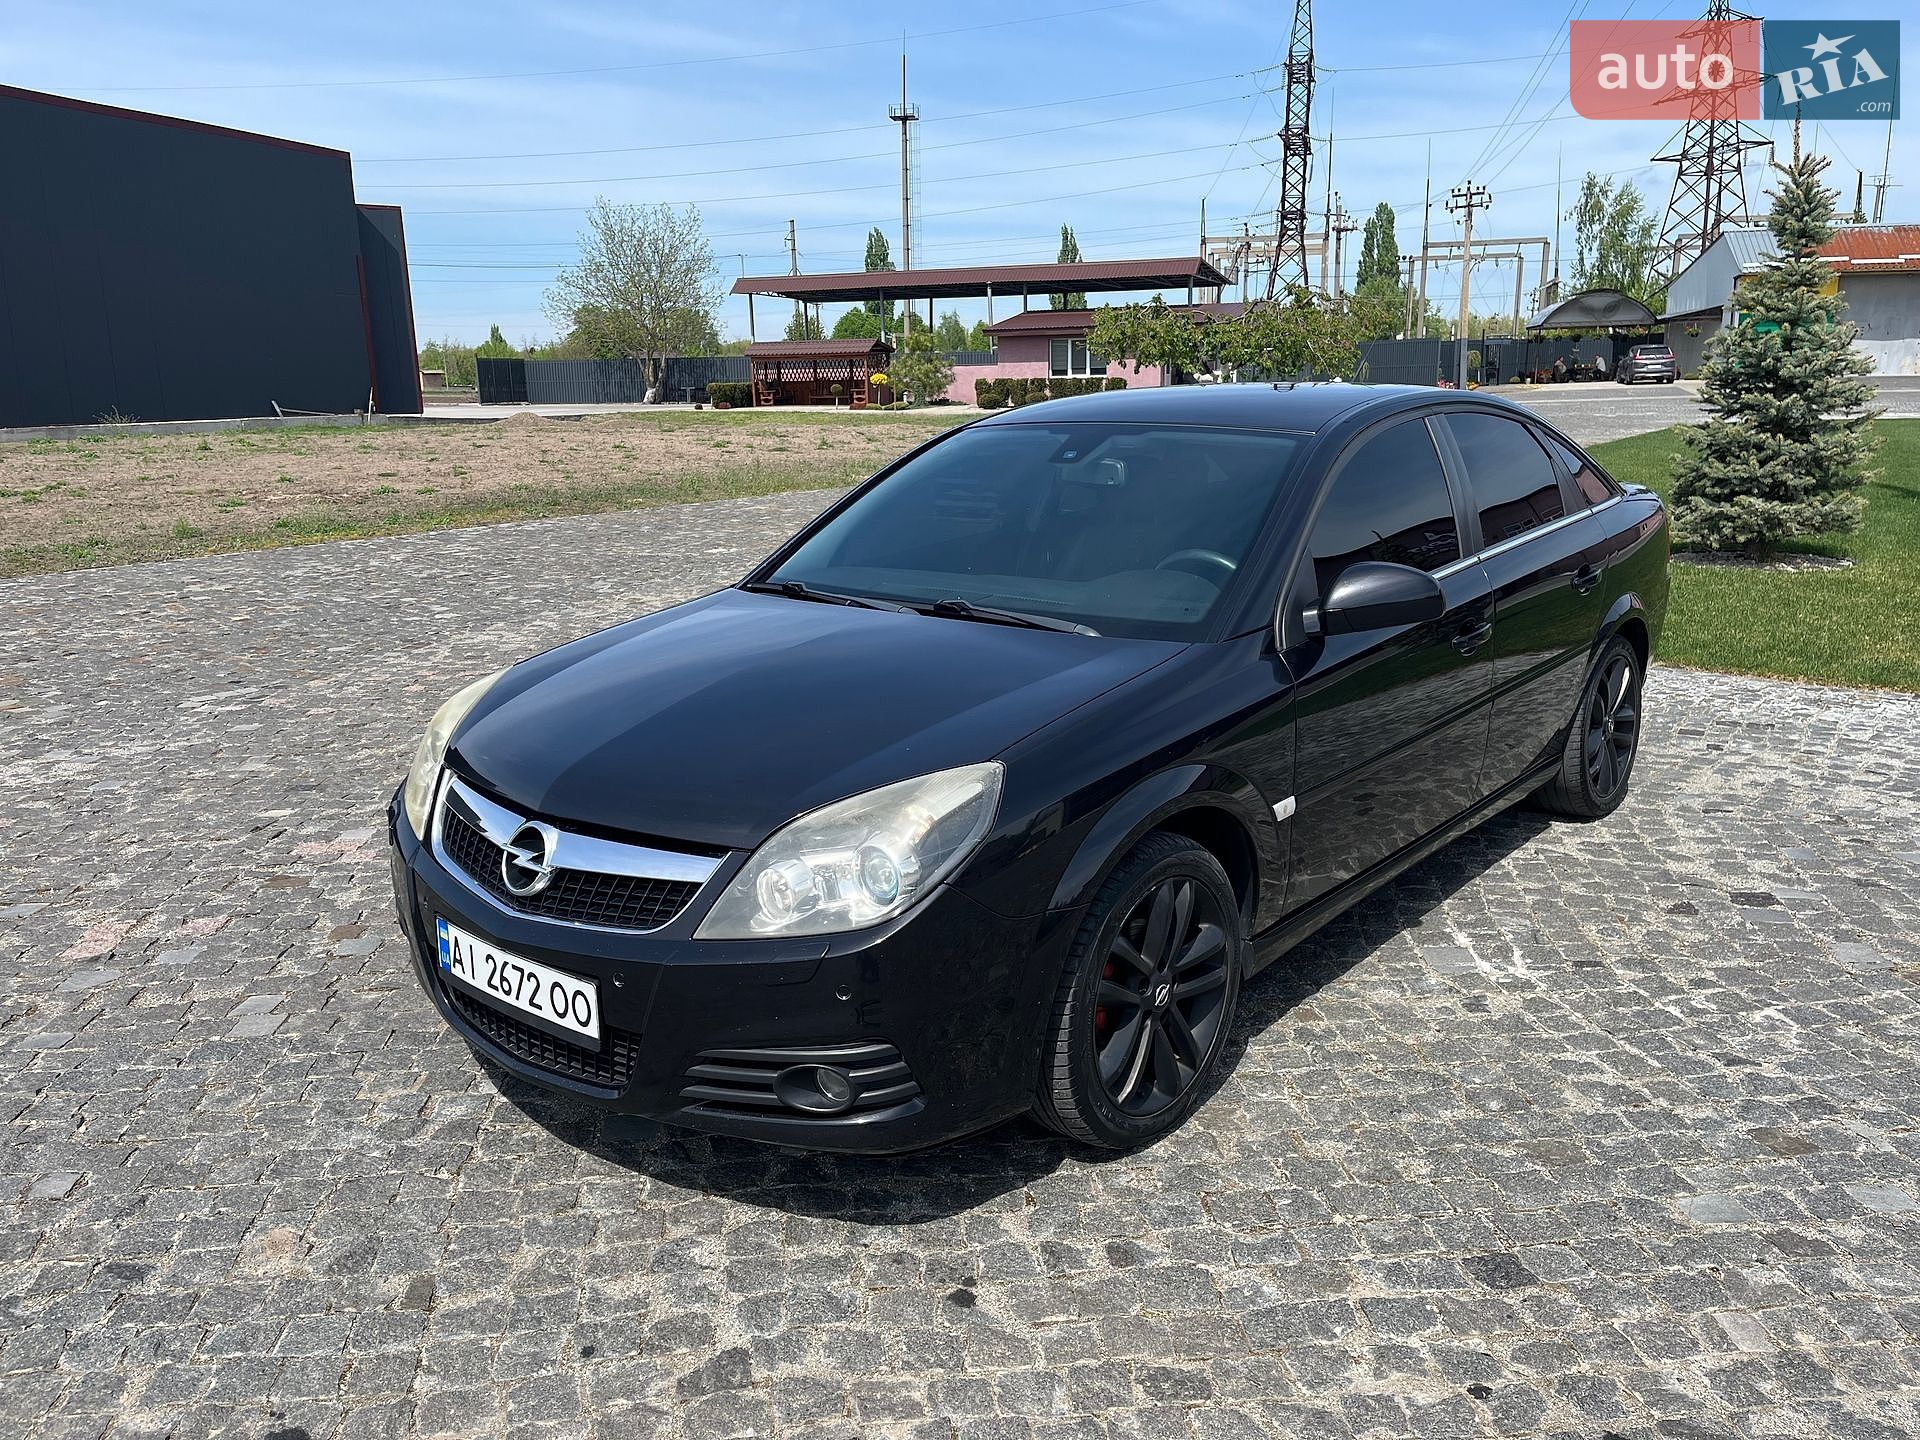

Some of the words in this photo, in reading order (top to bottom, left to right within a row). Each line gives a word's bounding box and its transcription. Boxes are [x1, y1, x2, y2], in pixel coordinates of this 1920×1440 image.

[441, 951, 451, 966] UA
[452, 936, 476, 980] AI
[485, 953, 543, 1011] 2672
[549, 981, 592, 1028] OO
